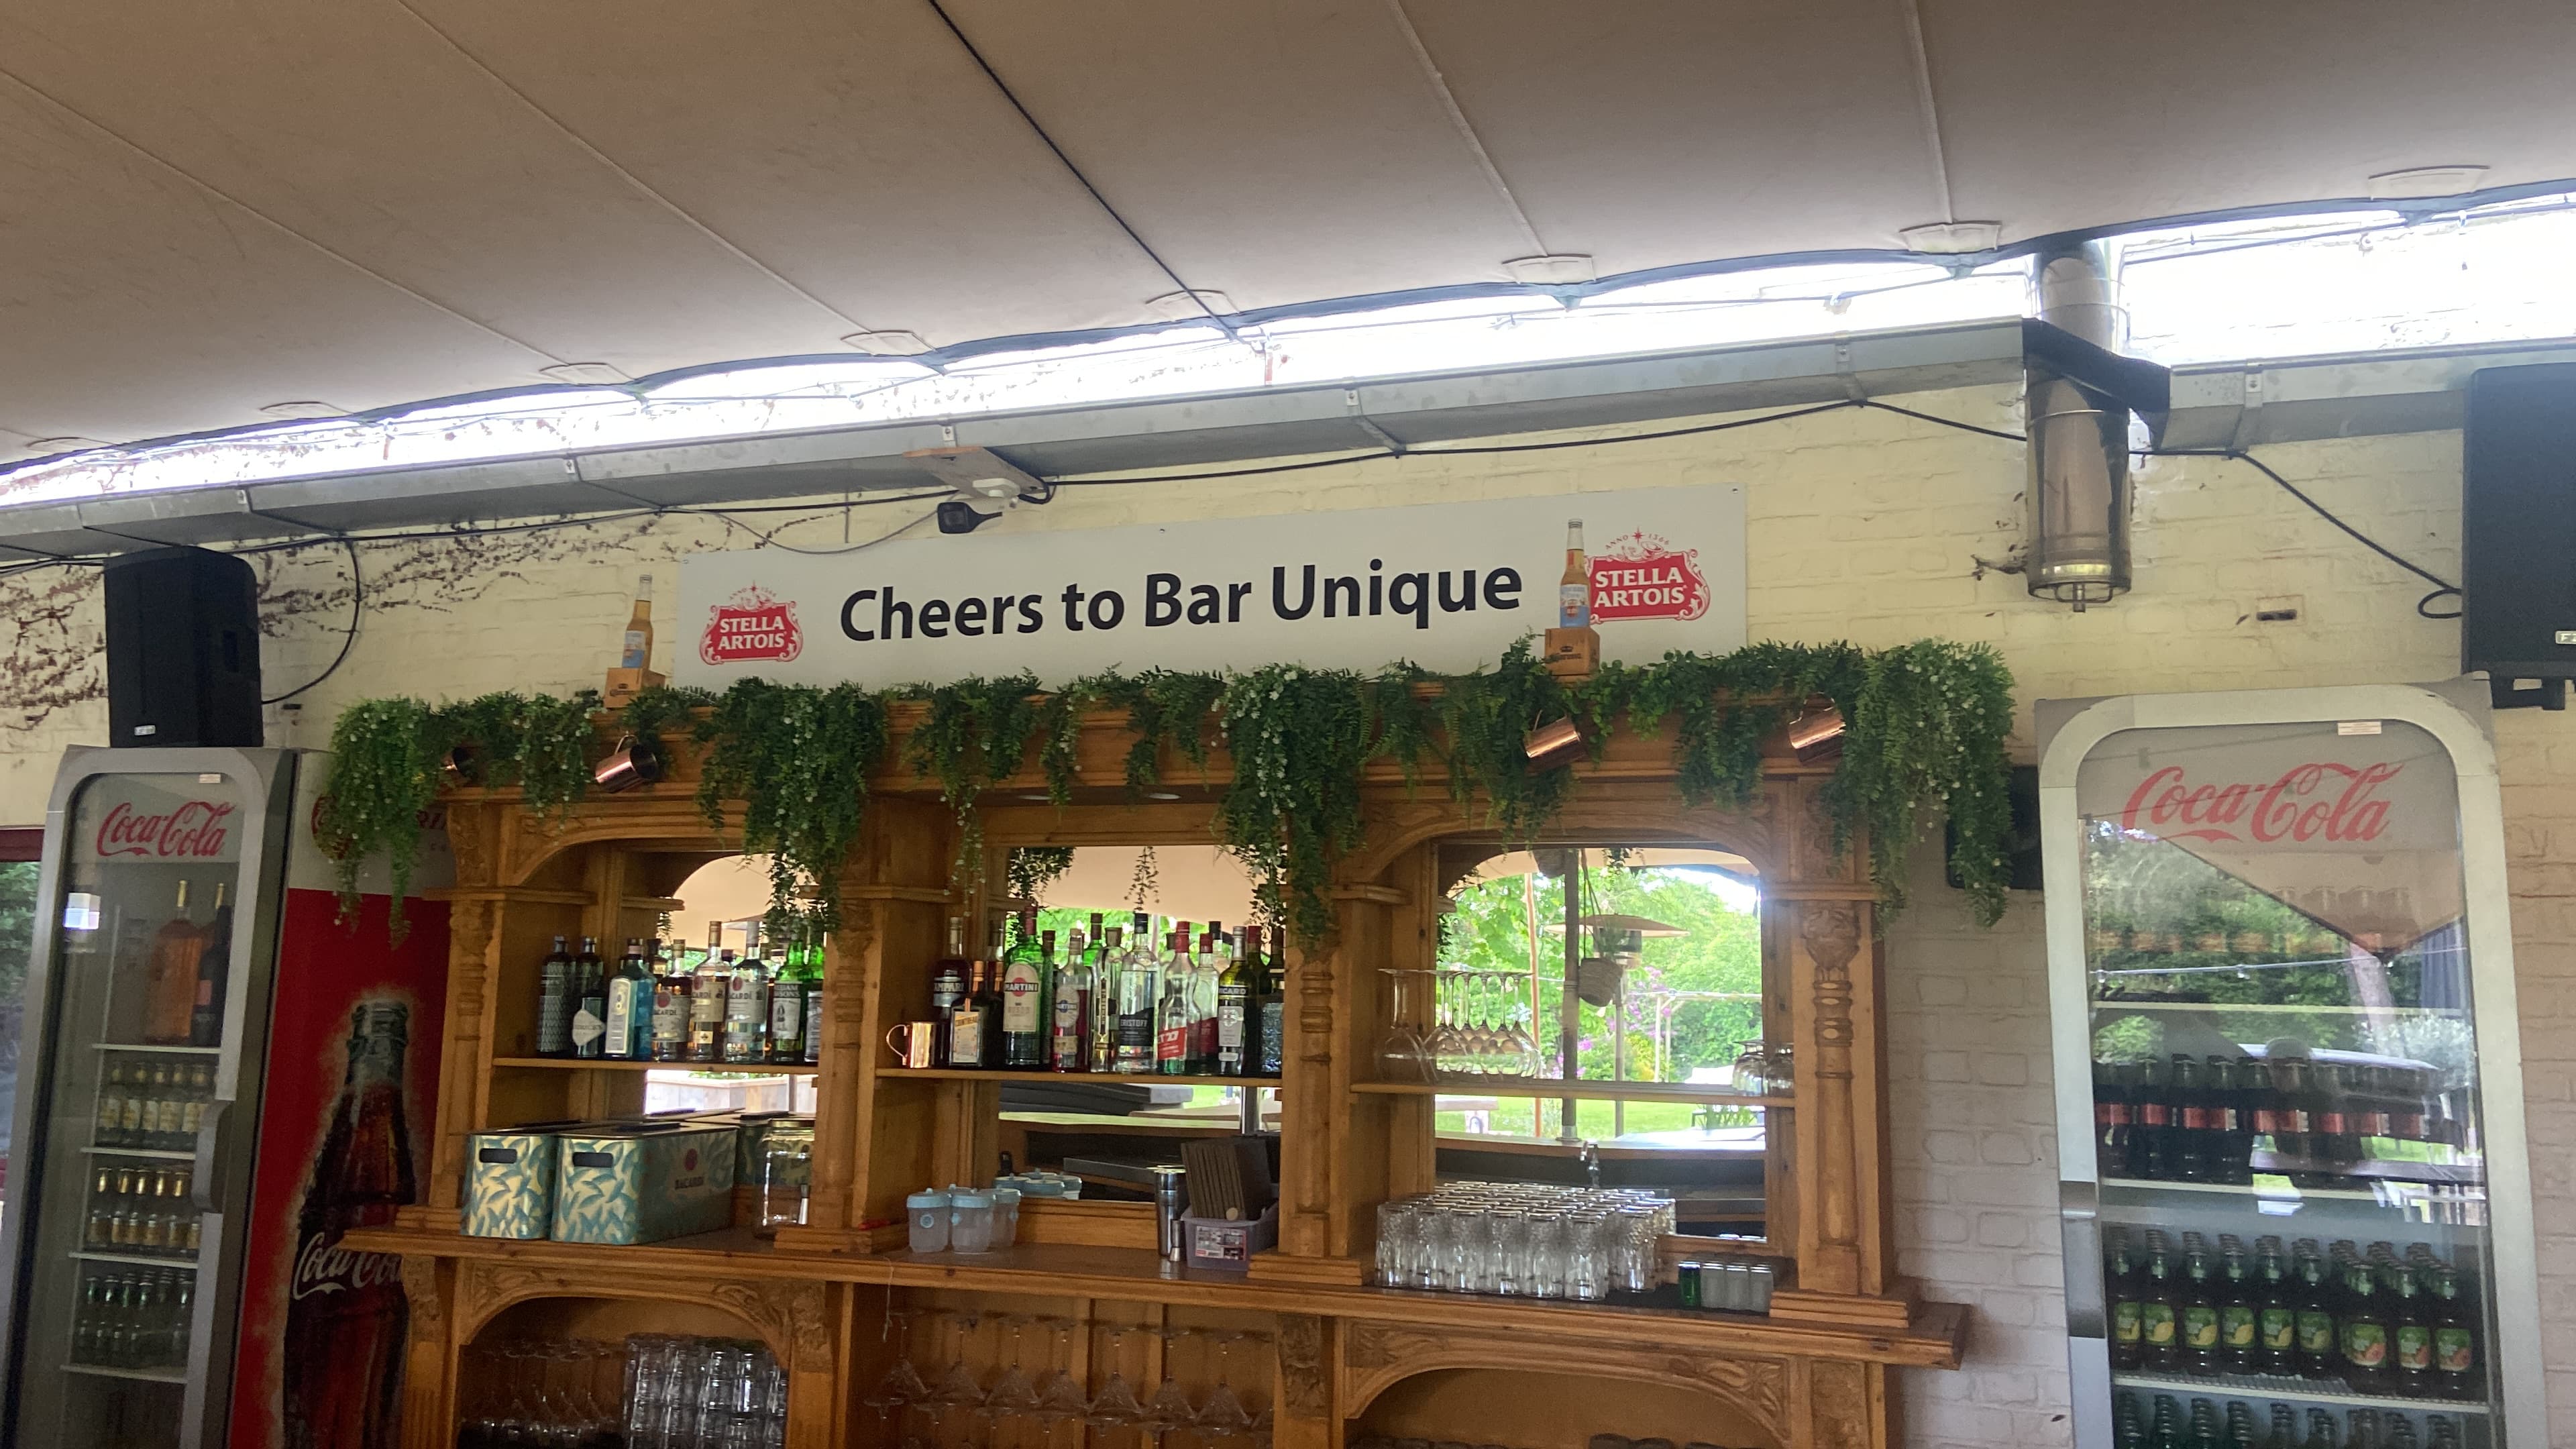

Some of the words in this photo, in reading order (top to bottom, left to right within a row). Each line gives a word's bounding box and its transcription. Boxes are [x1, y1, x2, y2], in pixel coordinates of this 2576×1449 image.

[1605, 534, 1629, 549] ANNO
[1648, 533, 1670, 545] 1366
[1595, 567, 1684, 588] STELLA
[841, 586, 1043, 641] Cheers
[1061, 583, 1124, 631] to
[1145, 573, 1252, 627] Bar
[1273, 558, 1522, 630] Unique
[1594, 587, 1686, 608] ARTOIS
[719, 616, 786, 633] STELLA
[718, 633, 786, 650] ARTOIS
